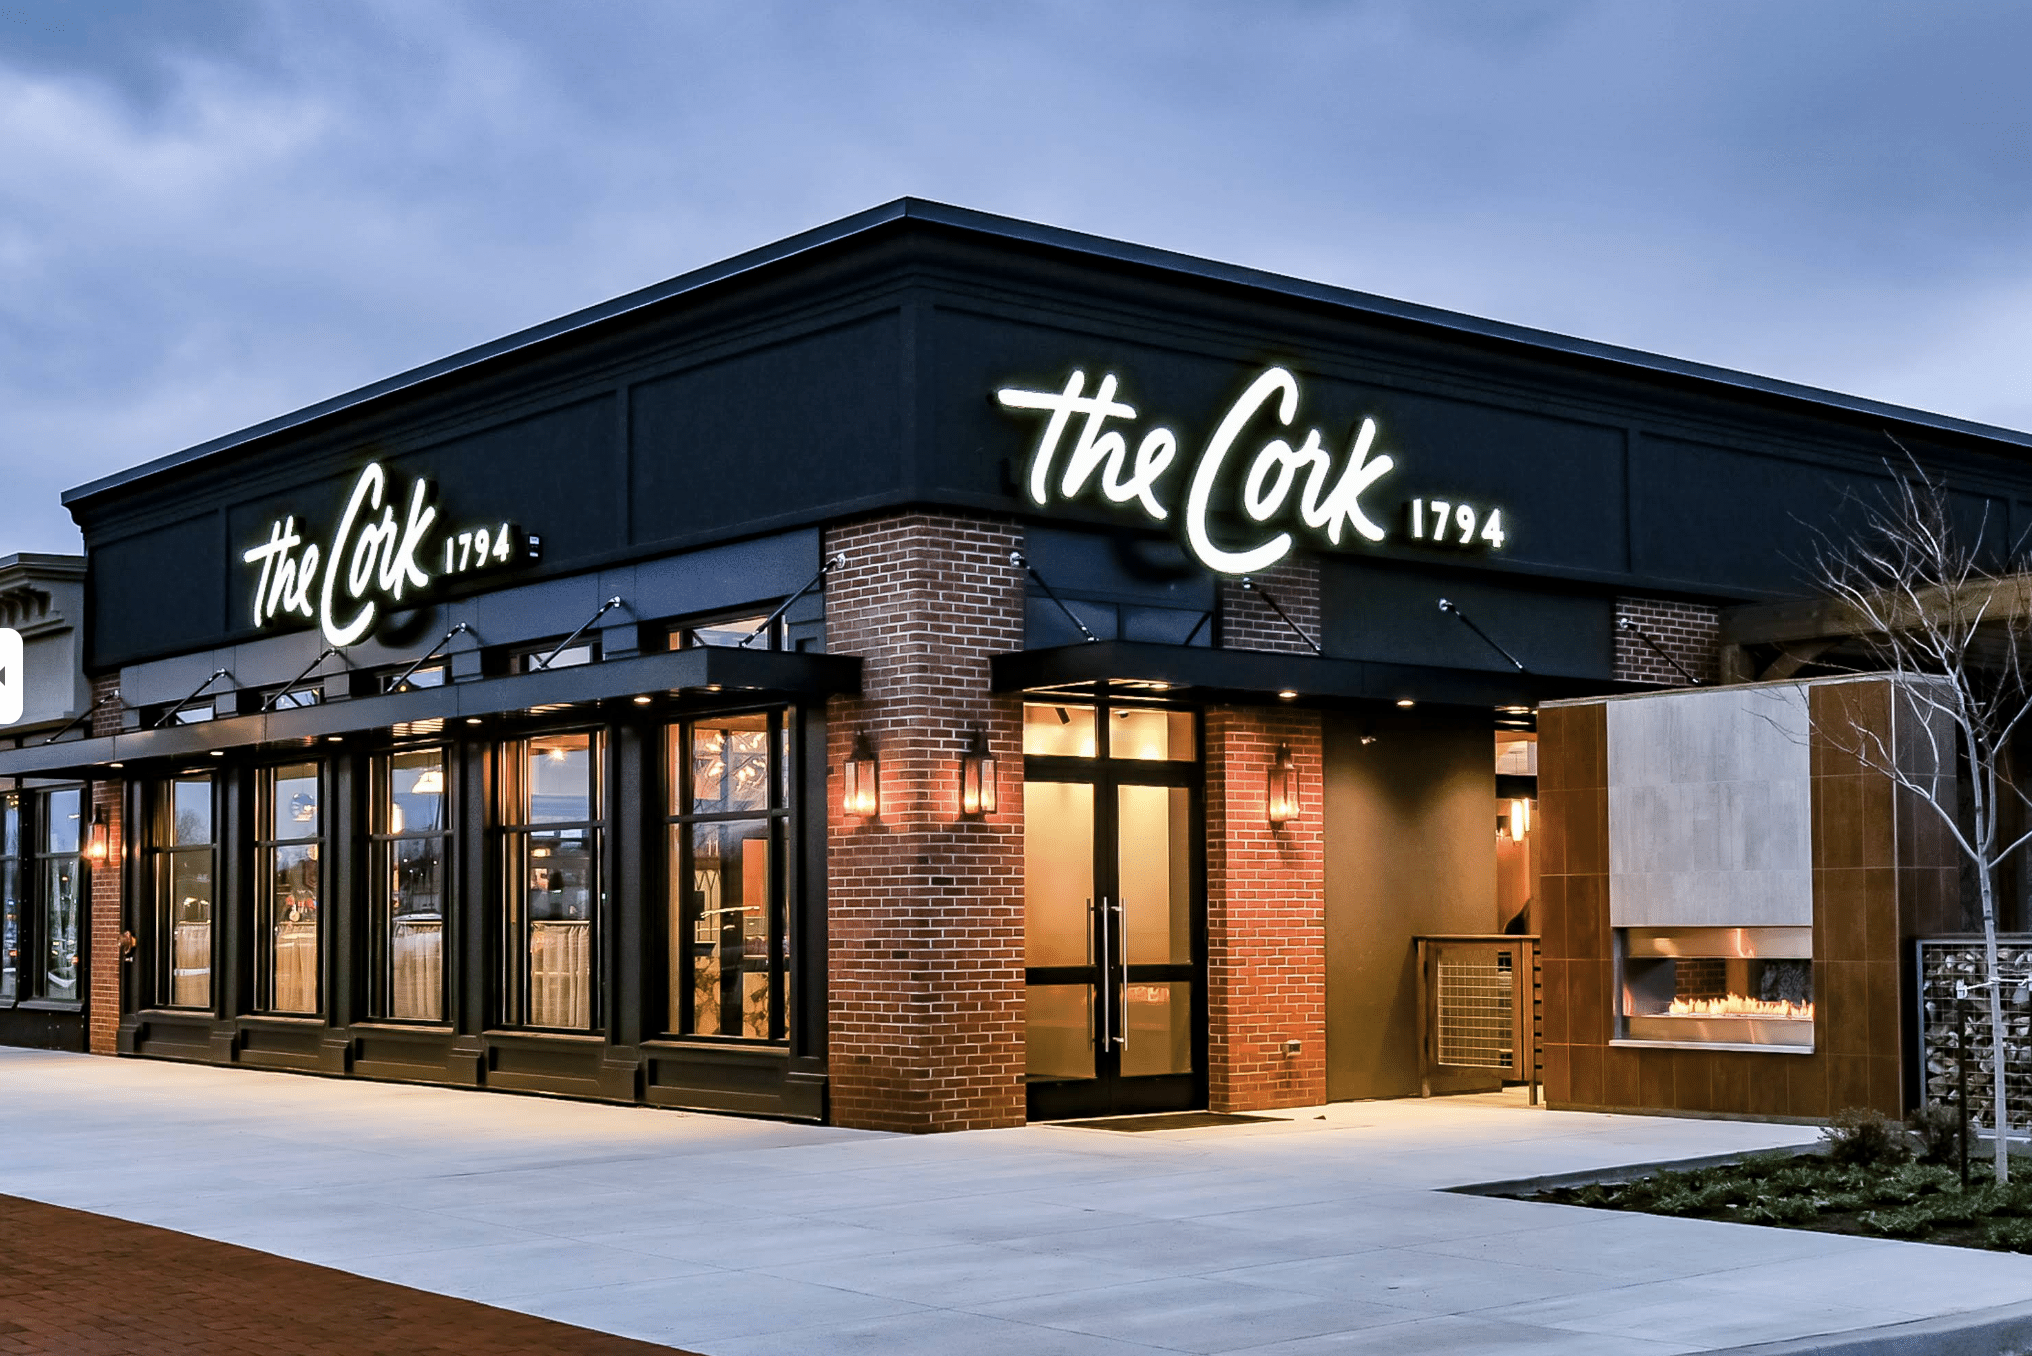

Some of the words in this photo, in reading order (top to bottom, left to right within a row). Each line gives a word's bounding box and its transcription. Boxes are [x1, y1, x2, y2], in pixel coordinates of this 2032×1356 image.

[320, 462, 436, 647] Cork
[445, 522, 510, 574] 1794
[1186, 366, 1394, 575] Cork
[1412, 498, 1505, 548] 1794
